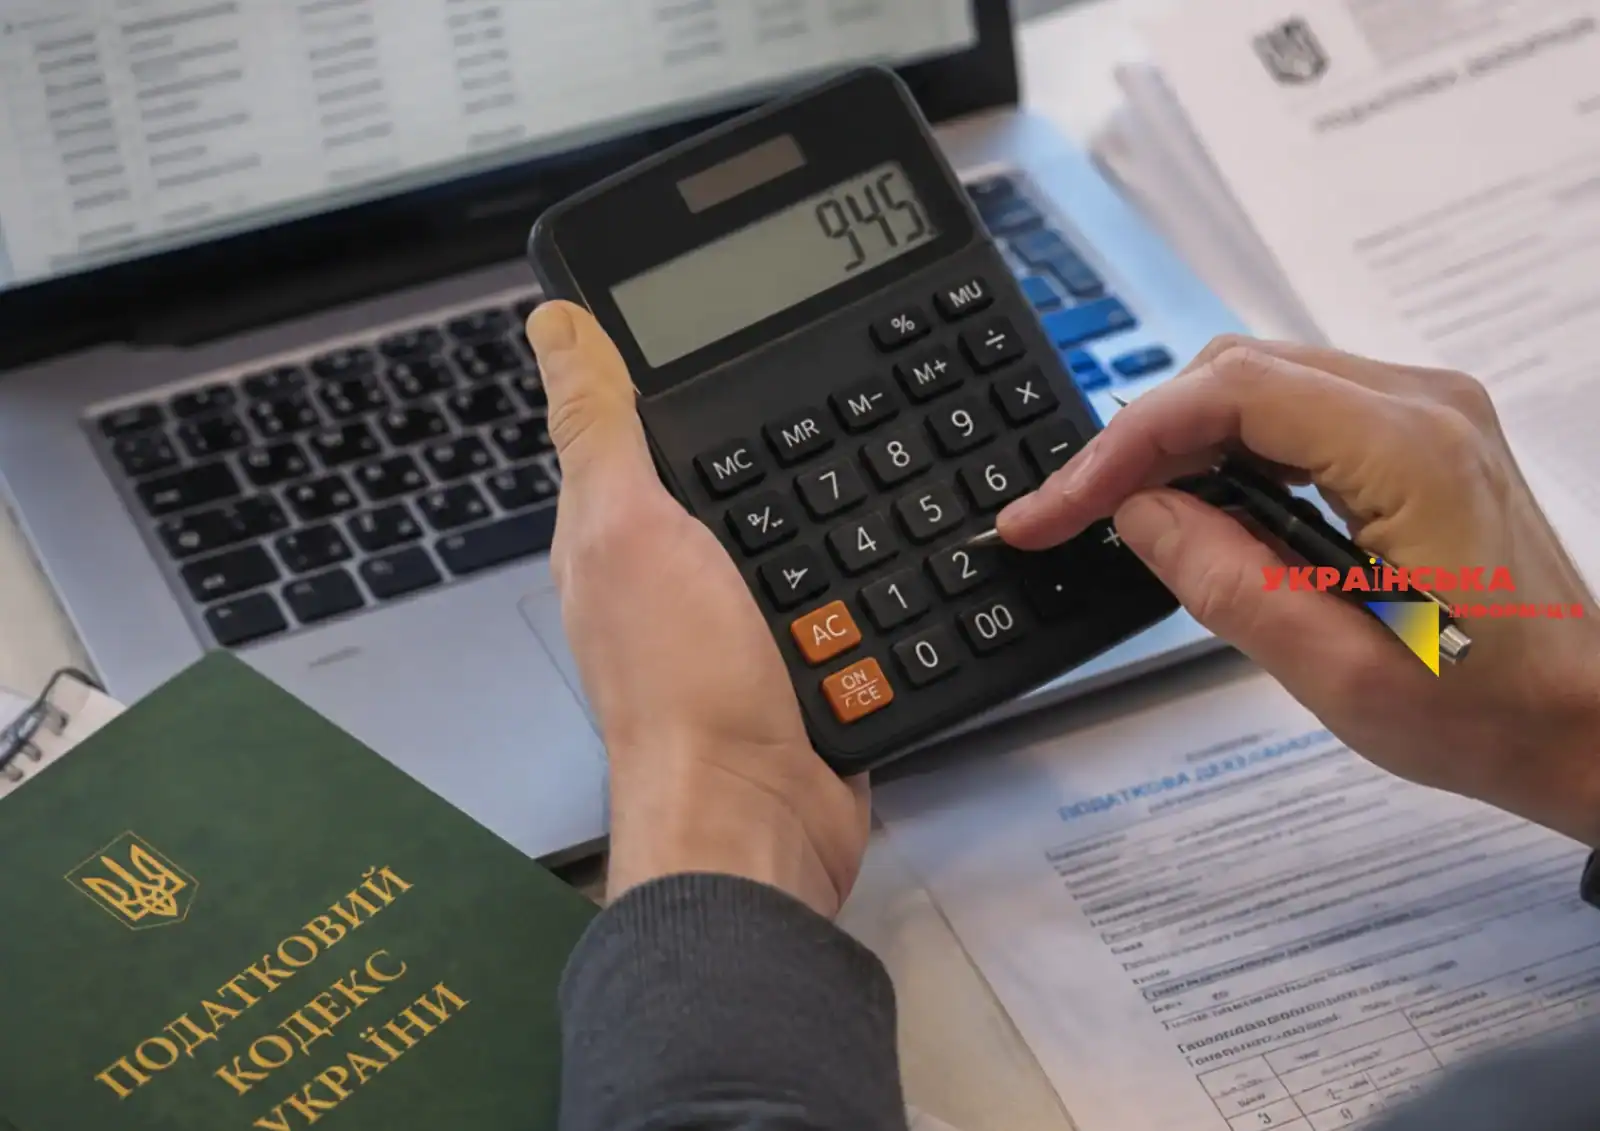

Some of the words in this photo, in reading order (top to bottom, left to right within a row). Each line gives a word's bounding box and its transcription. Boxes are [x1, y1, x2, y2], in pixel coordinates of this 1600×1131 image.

[815, 173, 926, 271] 945
[949, 281, 983, 307] MU
[891, 315, 915, 333] %
[914, 359, 947, 384] M+
[782, 419, 820, 447] MR
[952, 410, 974, 437] 9
[713, 449, 753, 480] MC
[887, 441, 910, 467] 8
[819, 471, 840, 499] 7
[986, 464, 1007, 492] 6
[920, 496, 942, 522] 5
[858, 526, 877, 551] 4
[953, 551, 977, 579] 2
[888, 584, 908, 609] 1
[813, 615, 847, 646] AC
[975, 605, 1013, 639] 00
[915, 641, 938, 668] 0
[841, 669, 867, 690] ON
[94, 865, 414, 1100] ПОДАТКОВИЙ
[214, 949, 408, 1096] КОДЕКС
